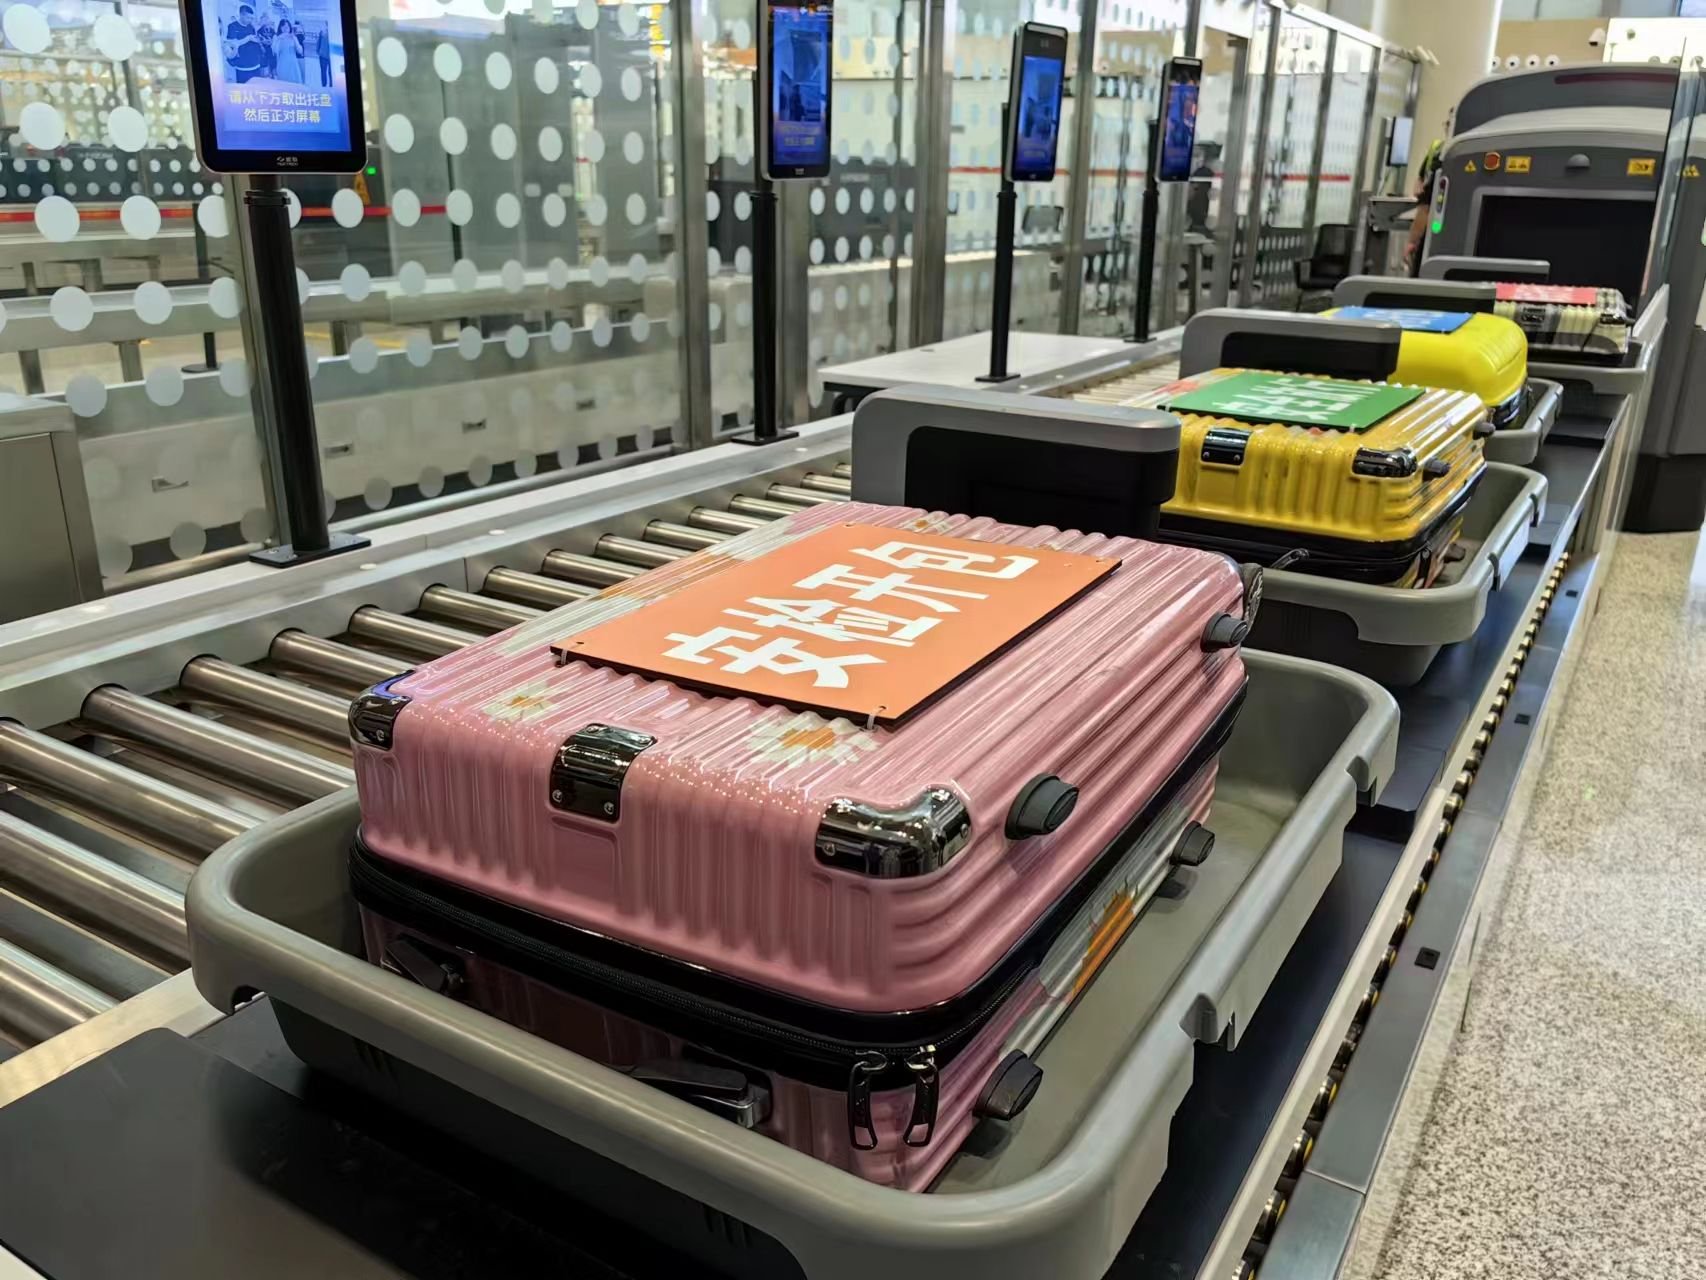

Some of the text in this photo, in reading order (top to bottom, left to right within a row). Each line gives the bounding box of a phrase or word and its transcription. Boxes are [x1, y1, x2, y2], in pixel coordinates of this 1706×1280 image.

[229, 90, 332, 107] 请从下方取出托盘
[244, 108, 321, 123] 然后正对屏幕
[661, 540, 1039, 689] 安检开包
